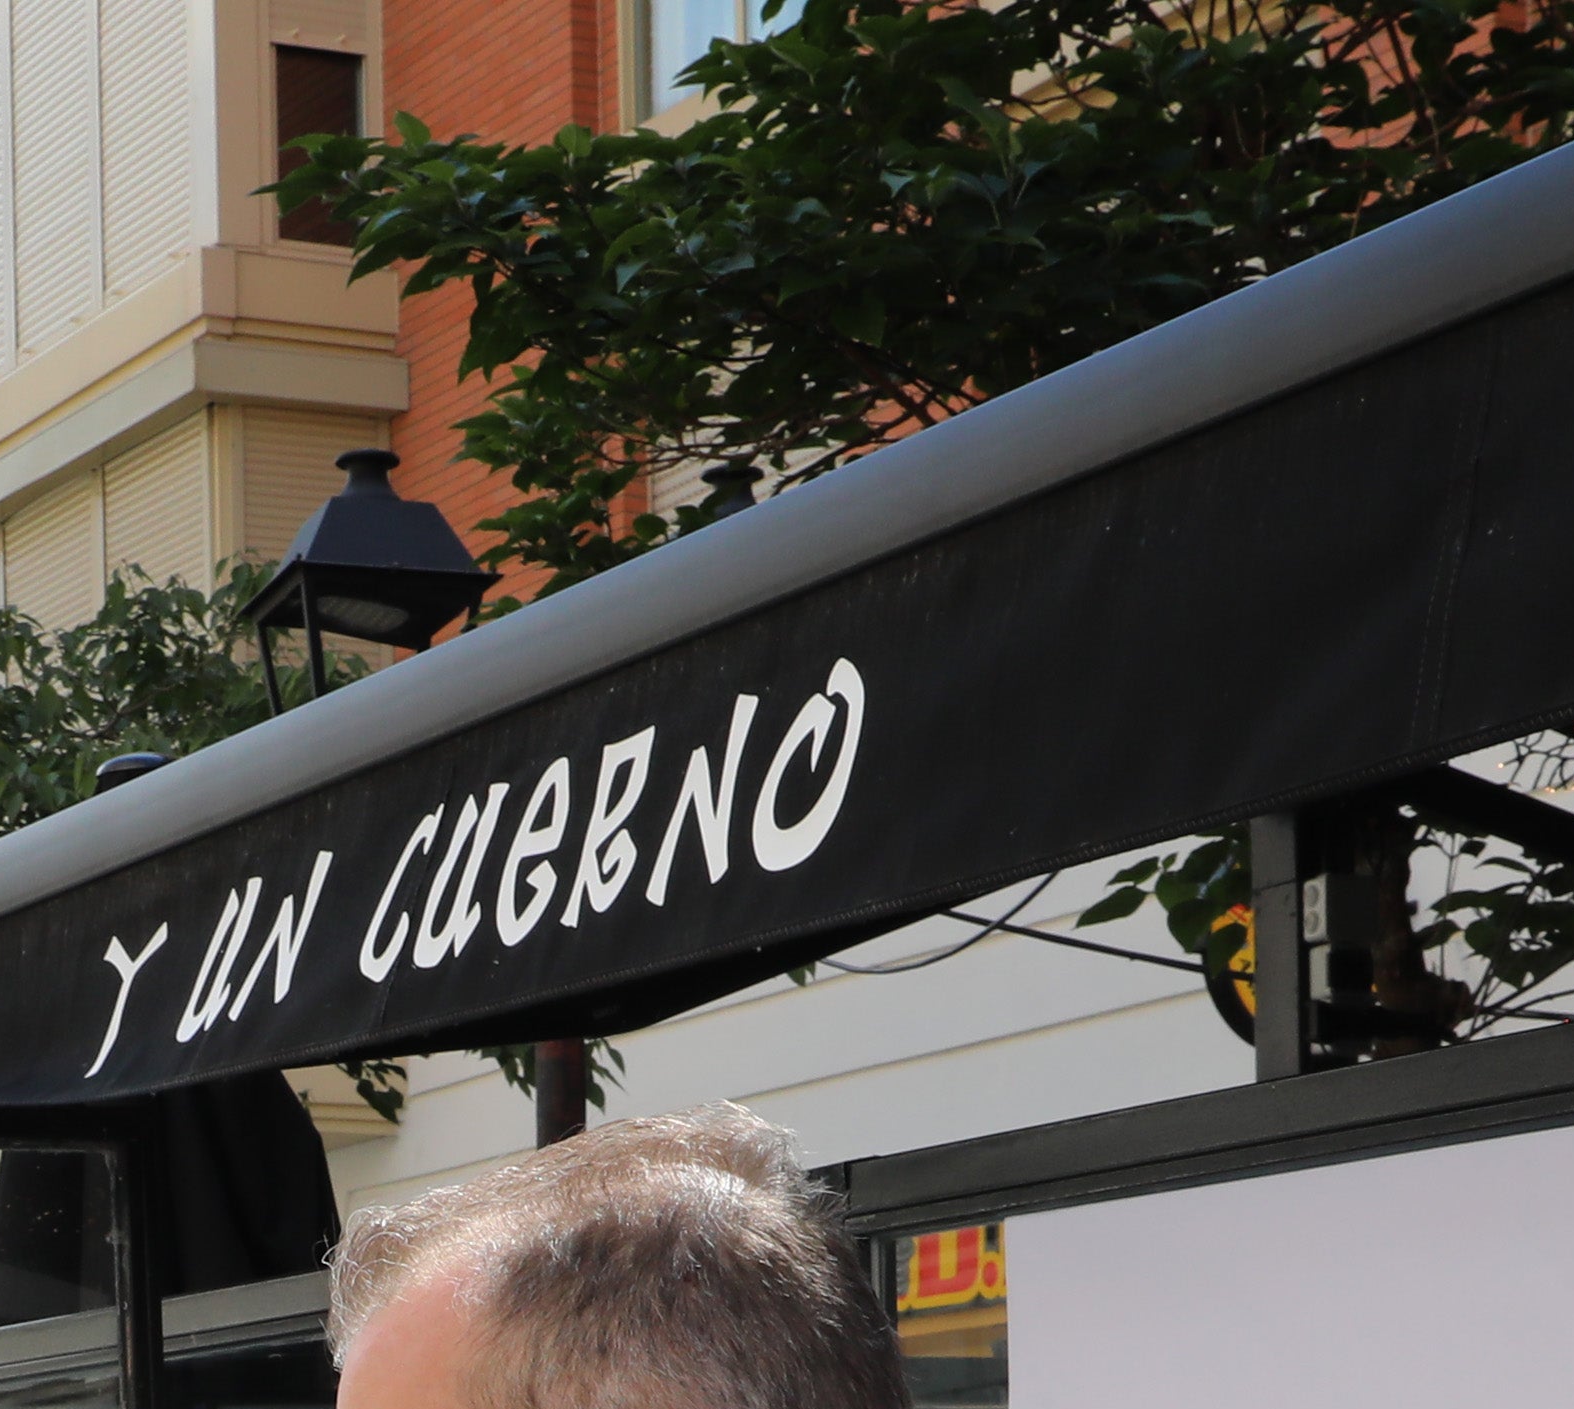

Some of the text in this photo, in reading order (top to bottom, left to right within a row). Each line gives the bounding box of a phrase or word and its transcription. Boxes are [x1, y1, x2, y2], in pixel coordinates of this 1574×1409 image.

[85, 657, 865, 1078] Y UN CUERNO
